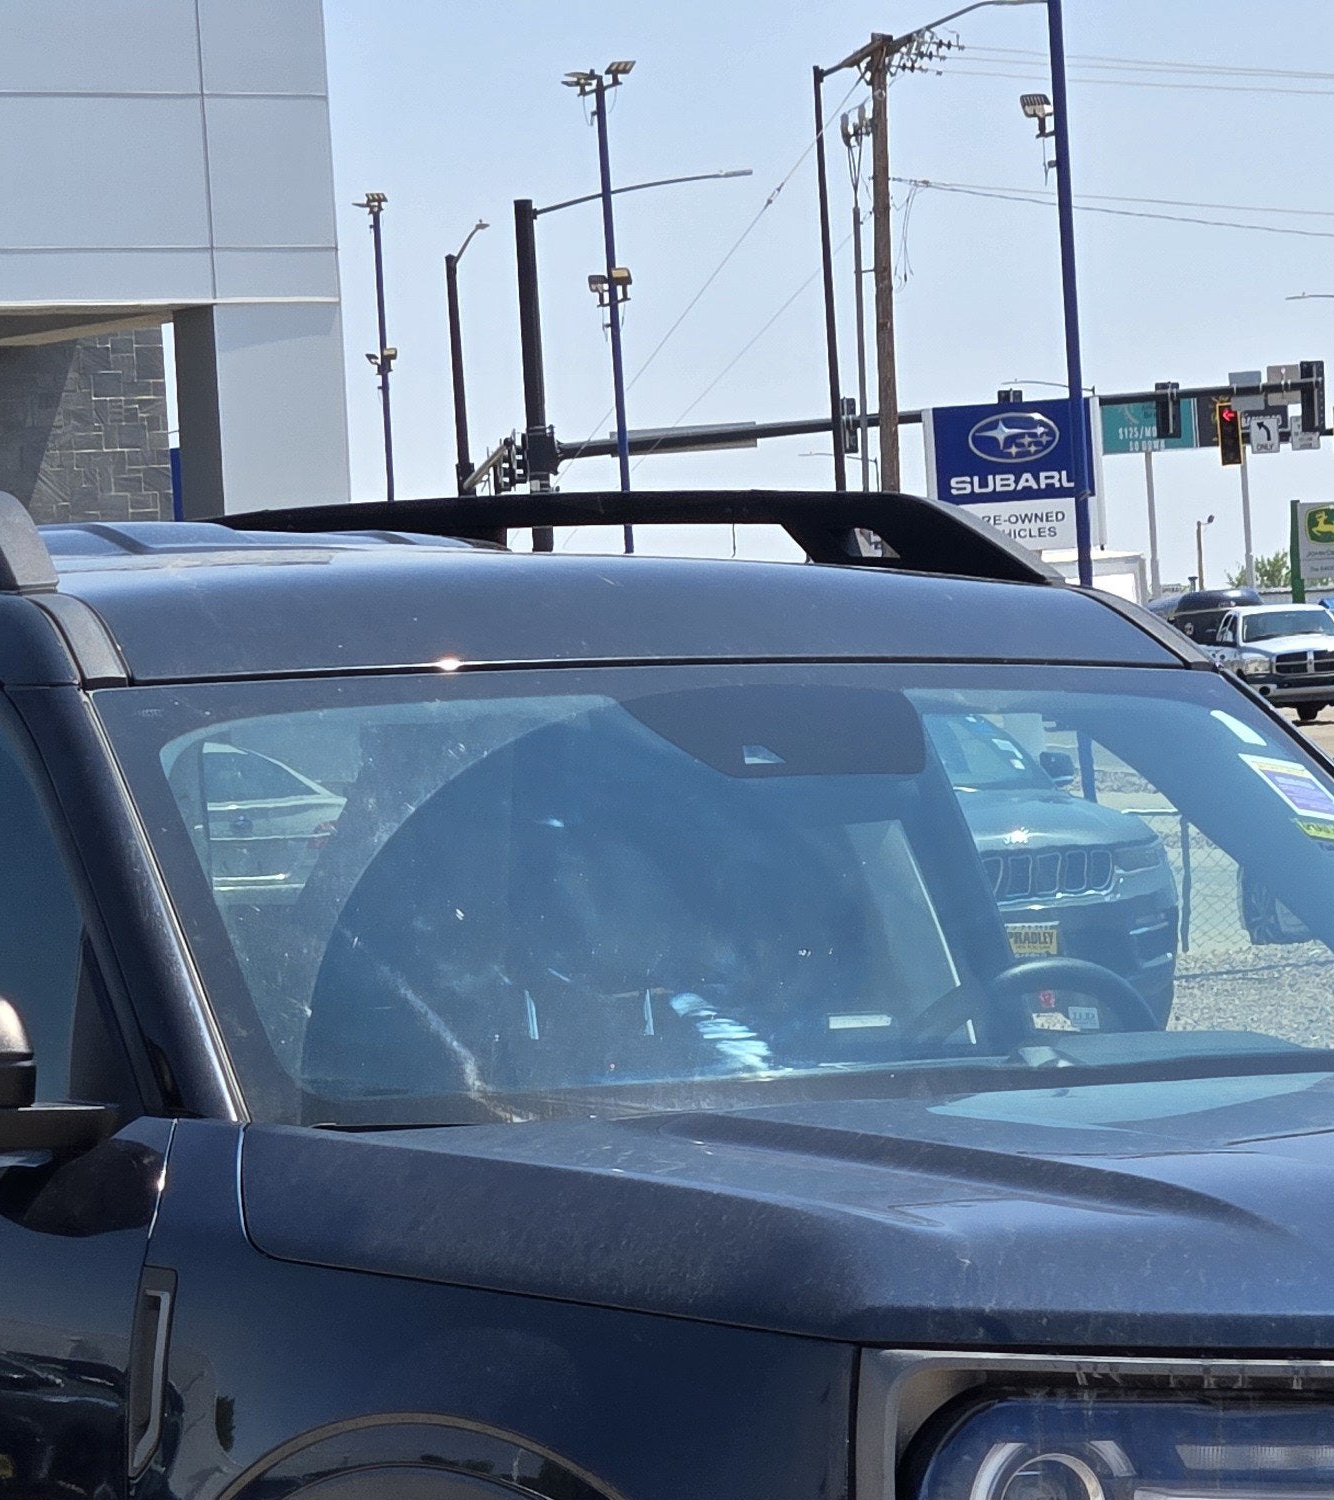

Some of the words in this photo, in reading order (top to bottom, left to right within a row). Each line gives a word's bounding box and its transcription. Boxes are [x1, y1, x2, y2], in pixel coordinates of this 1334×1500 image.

[982, 510, 1065, 526] RE-OWNED
[1002, 526, 1057, 539] HICLES
[1008, 931, 1054, 945] PRADLEY
